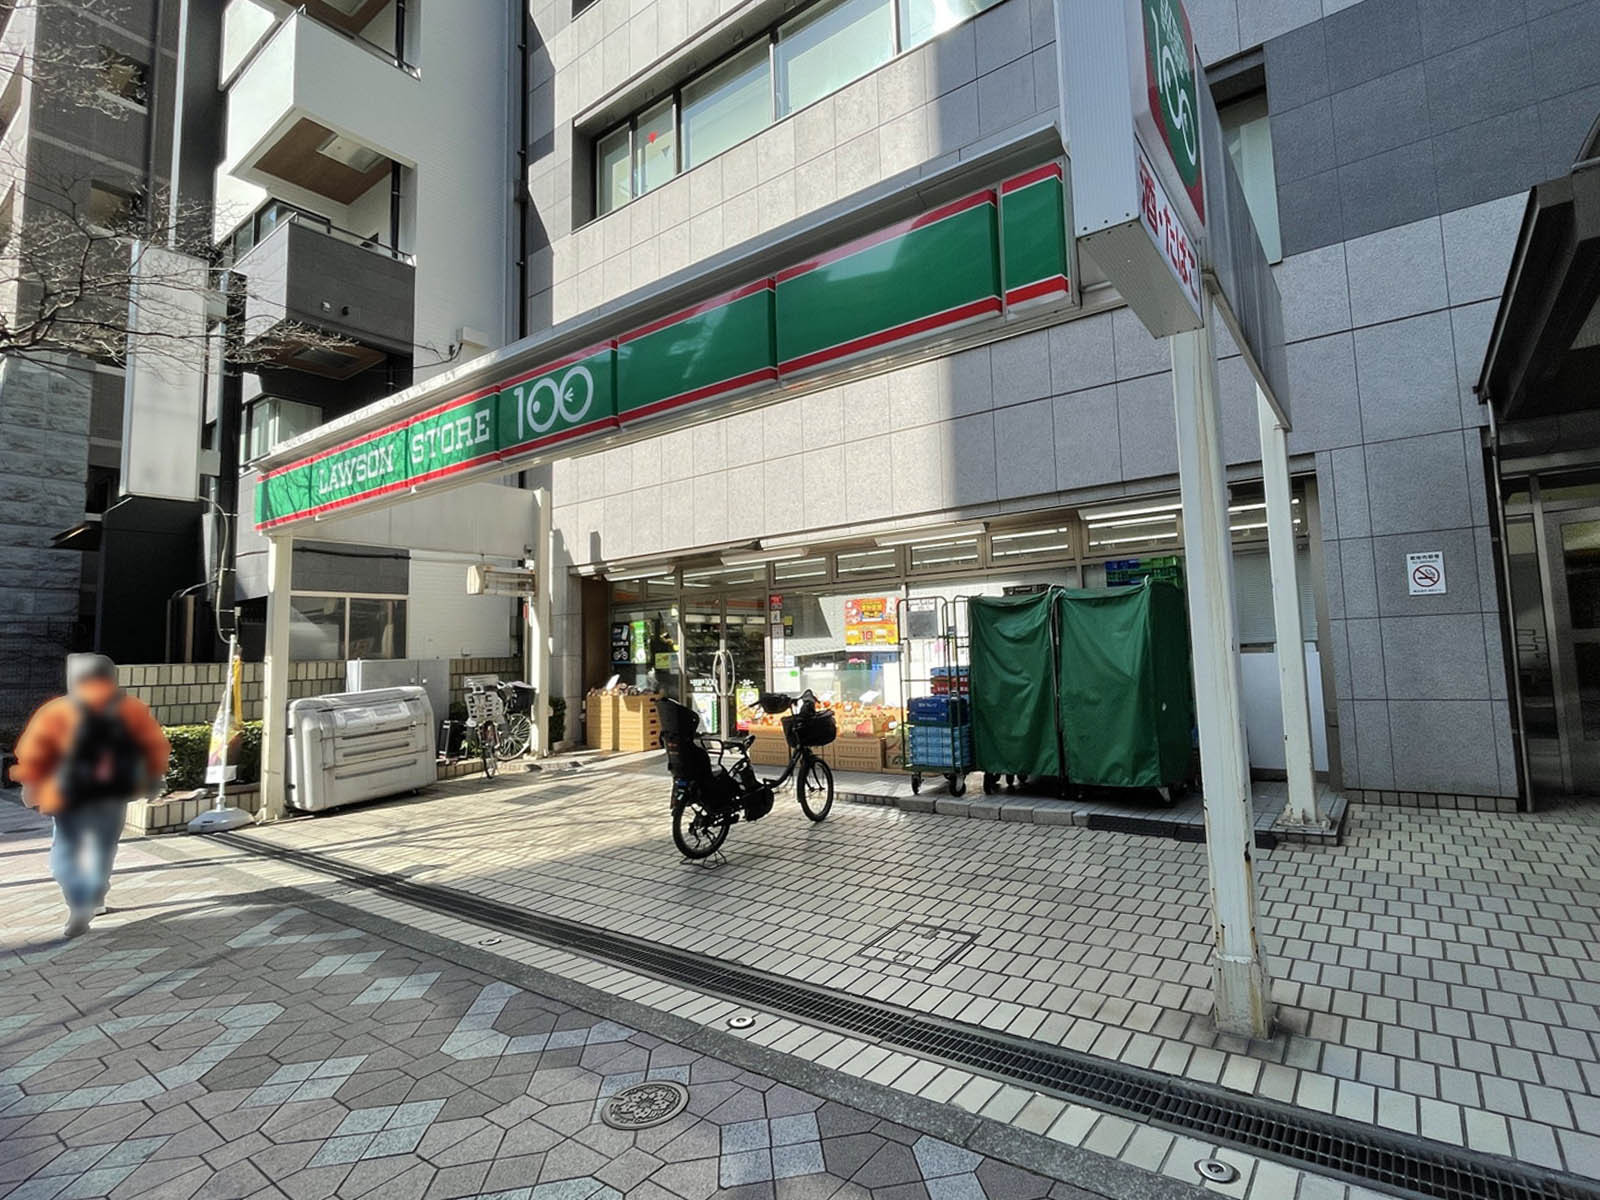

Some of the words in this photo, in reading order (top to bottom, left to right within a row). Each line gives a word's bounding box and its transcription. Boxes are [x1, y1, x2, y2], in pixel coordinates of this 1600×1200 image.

[1138, 153, 1199, 303] 酒・たばこ
[318, 444, 395, 495] LAWSON
[408, 408, 491, 463] STORE
[514, 366, 594, 440] 100
